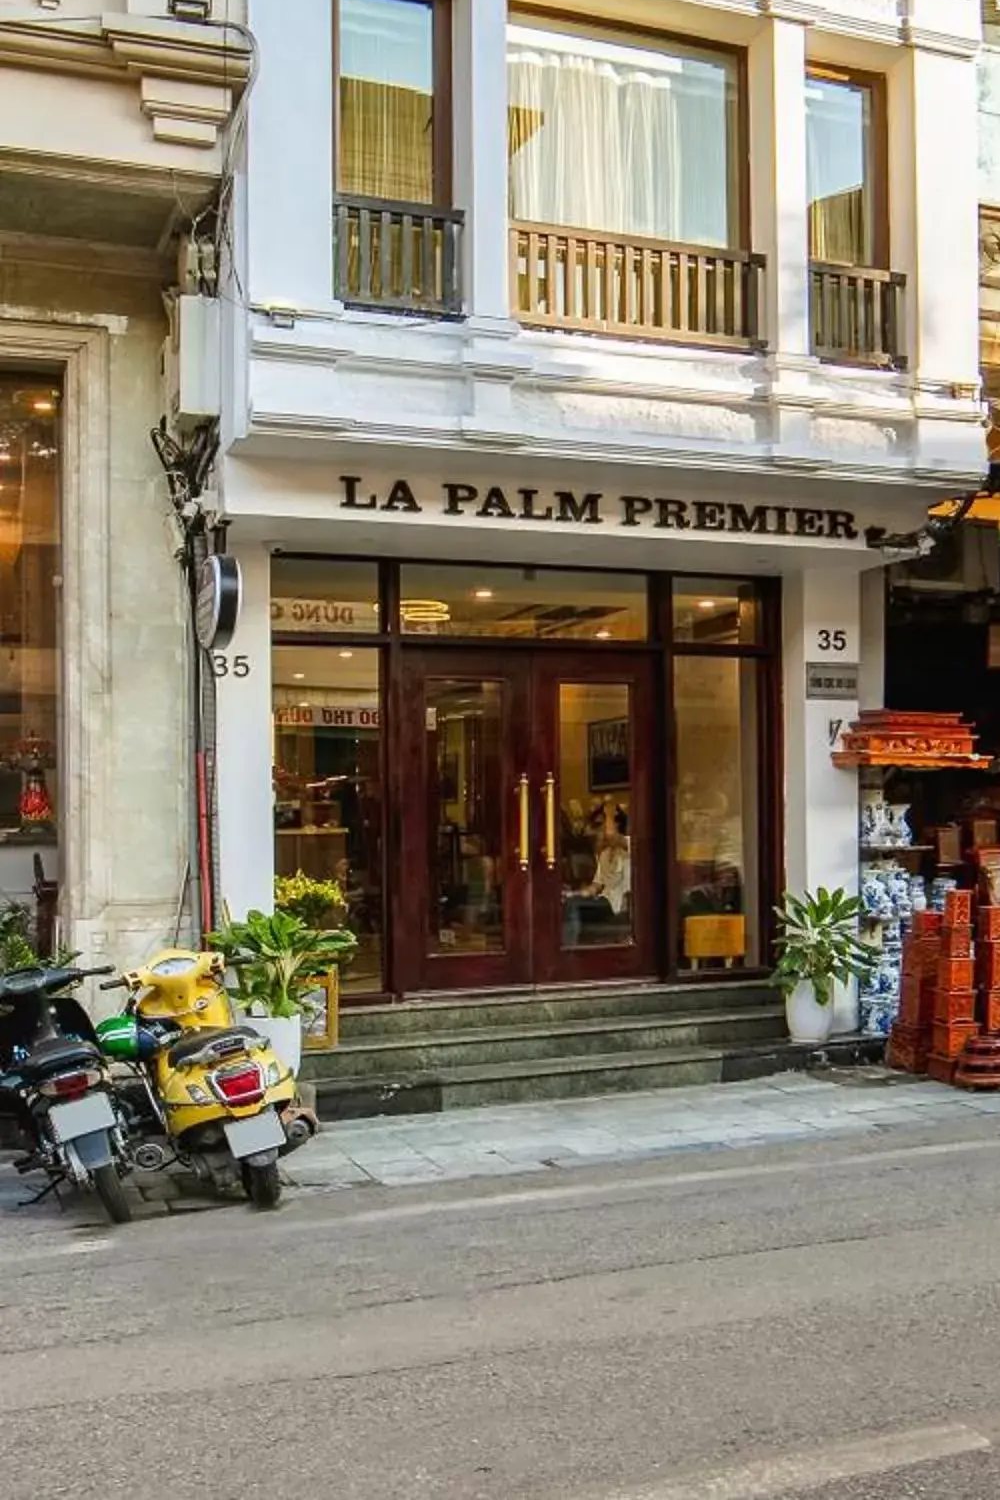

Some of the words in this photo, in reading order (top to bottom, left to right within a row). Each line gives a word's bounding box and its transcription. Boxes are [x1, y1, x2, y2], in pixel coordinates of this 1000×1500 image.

[339, 475, 421, 511] LA
[441, 483, 603, 524] PALM
[619, 495, 859, 540] PREMIER
[818, 629, 847, 651] 35
[213, 655, 250, 678] 35
